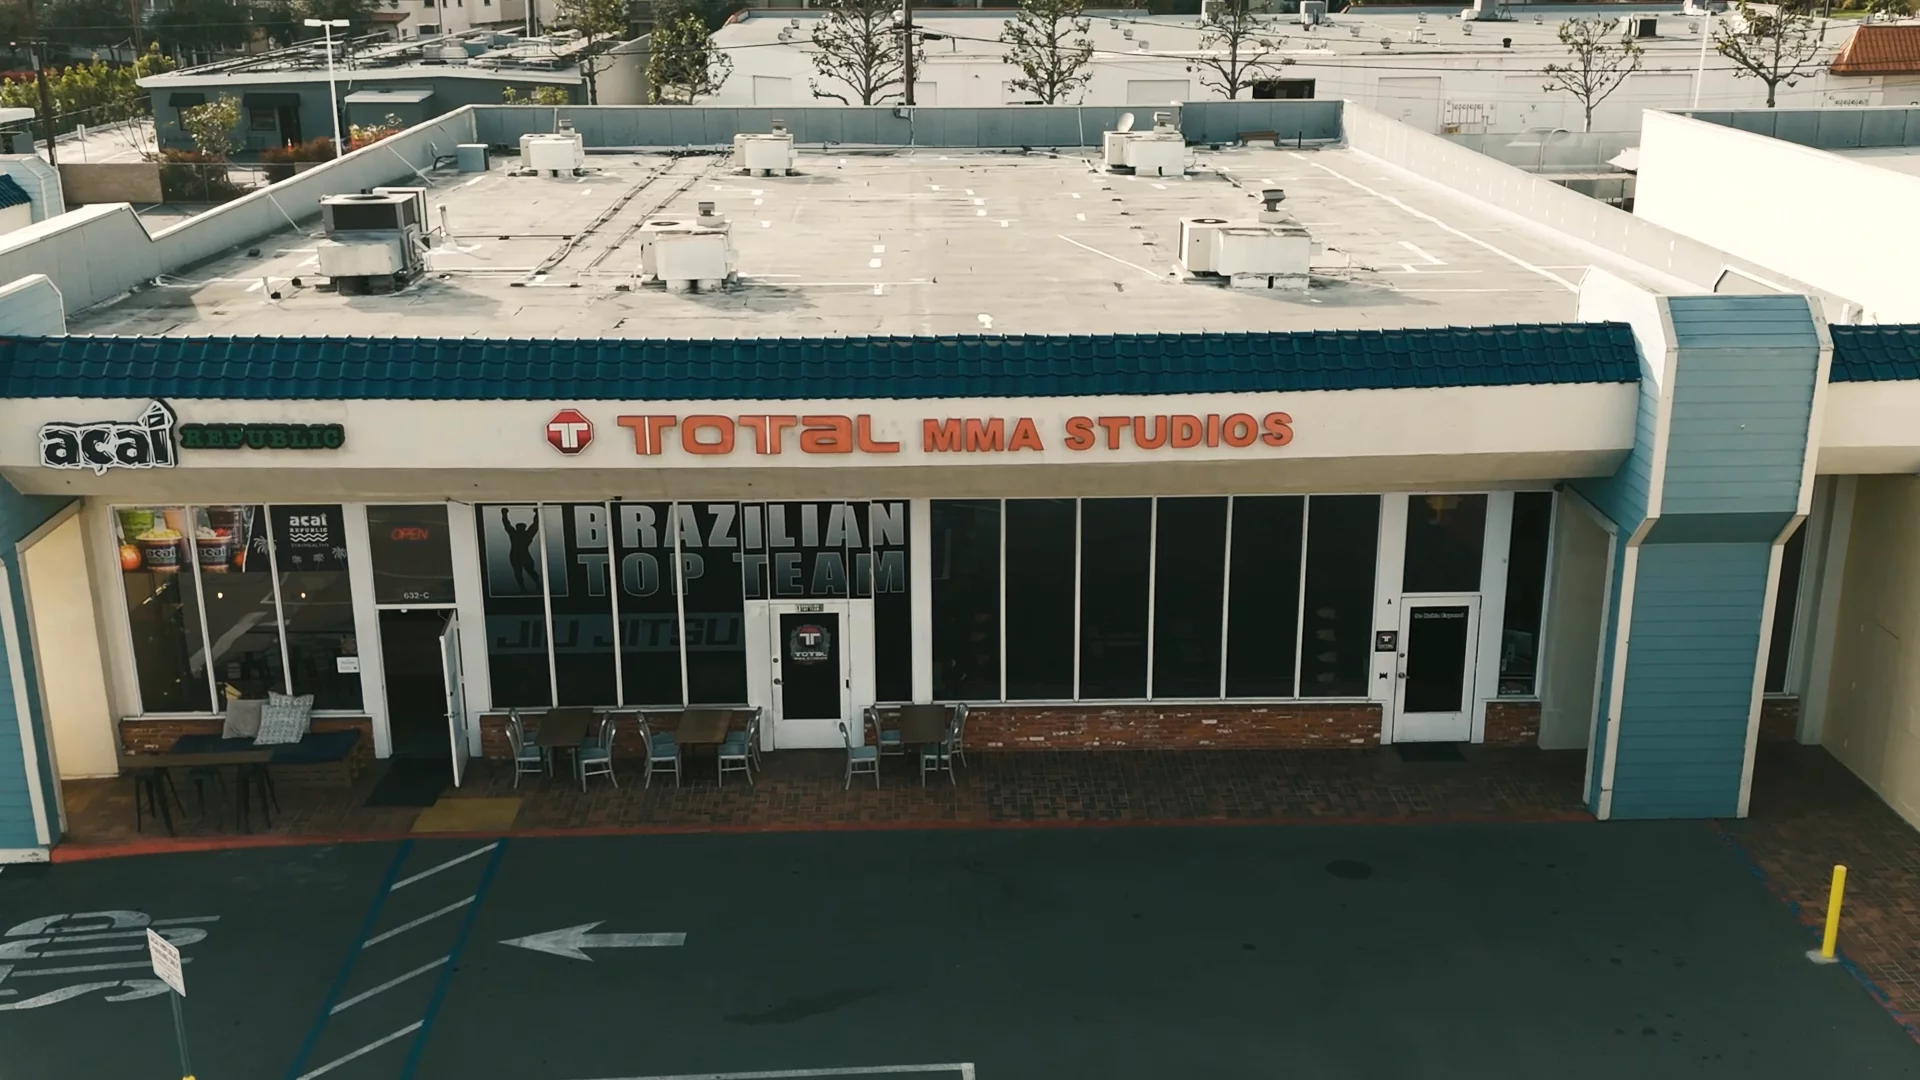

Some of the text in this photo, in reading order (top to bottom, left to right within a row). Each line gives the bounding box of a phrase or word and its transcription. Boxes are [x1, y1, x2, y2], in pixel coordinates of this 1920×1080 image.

[181, 424, 344, 448] REPUBLIC
[923, 418, 1044, 453] MMA
[1064, 412, 1294, 451] STUDIOS
[391, 527, 428, 540] OPEN
[574, 502, 905, 549] BRAZILIAN
[577, 550, 906, 598] TOP TEAM
[403, 592, 430, 600] 632-C
[496, 617, 740, 649] JIU JITSU
